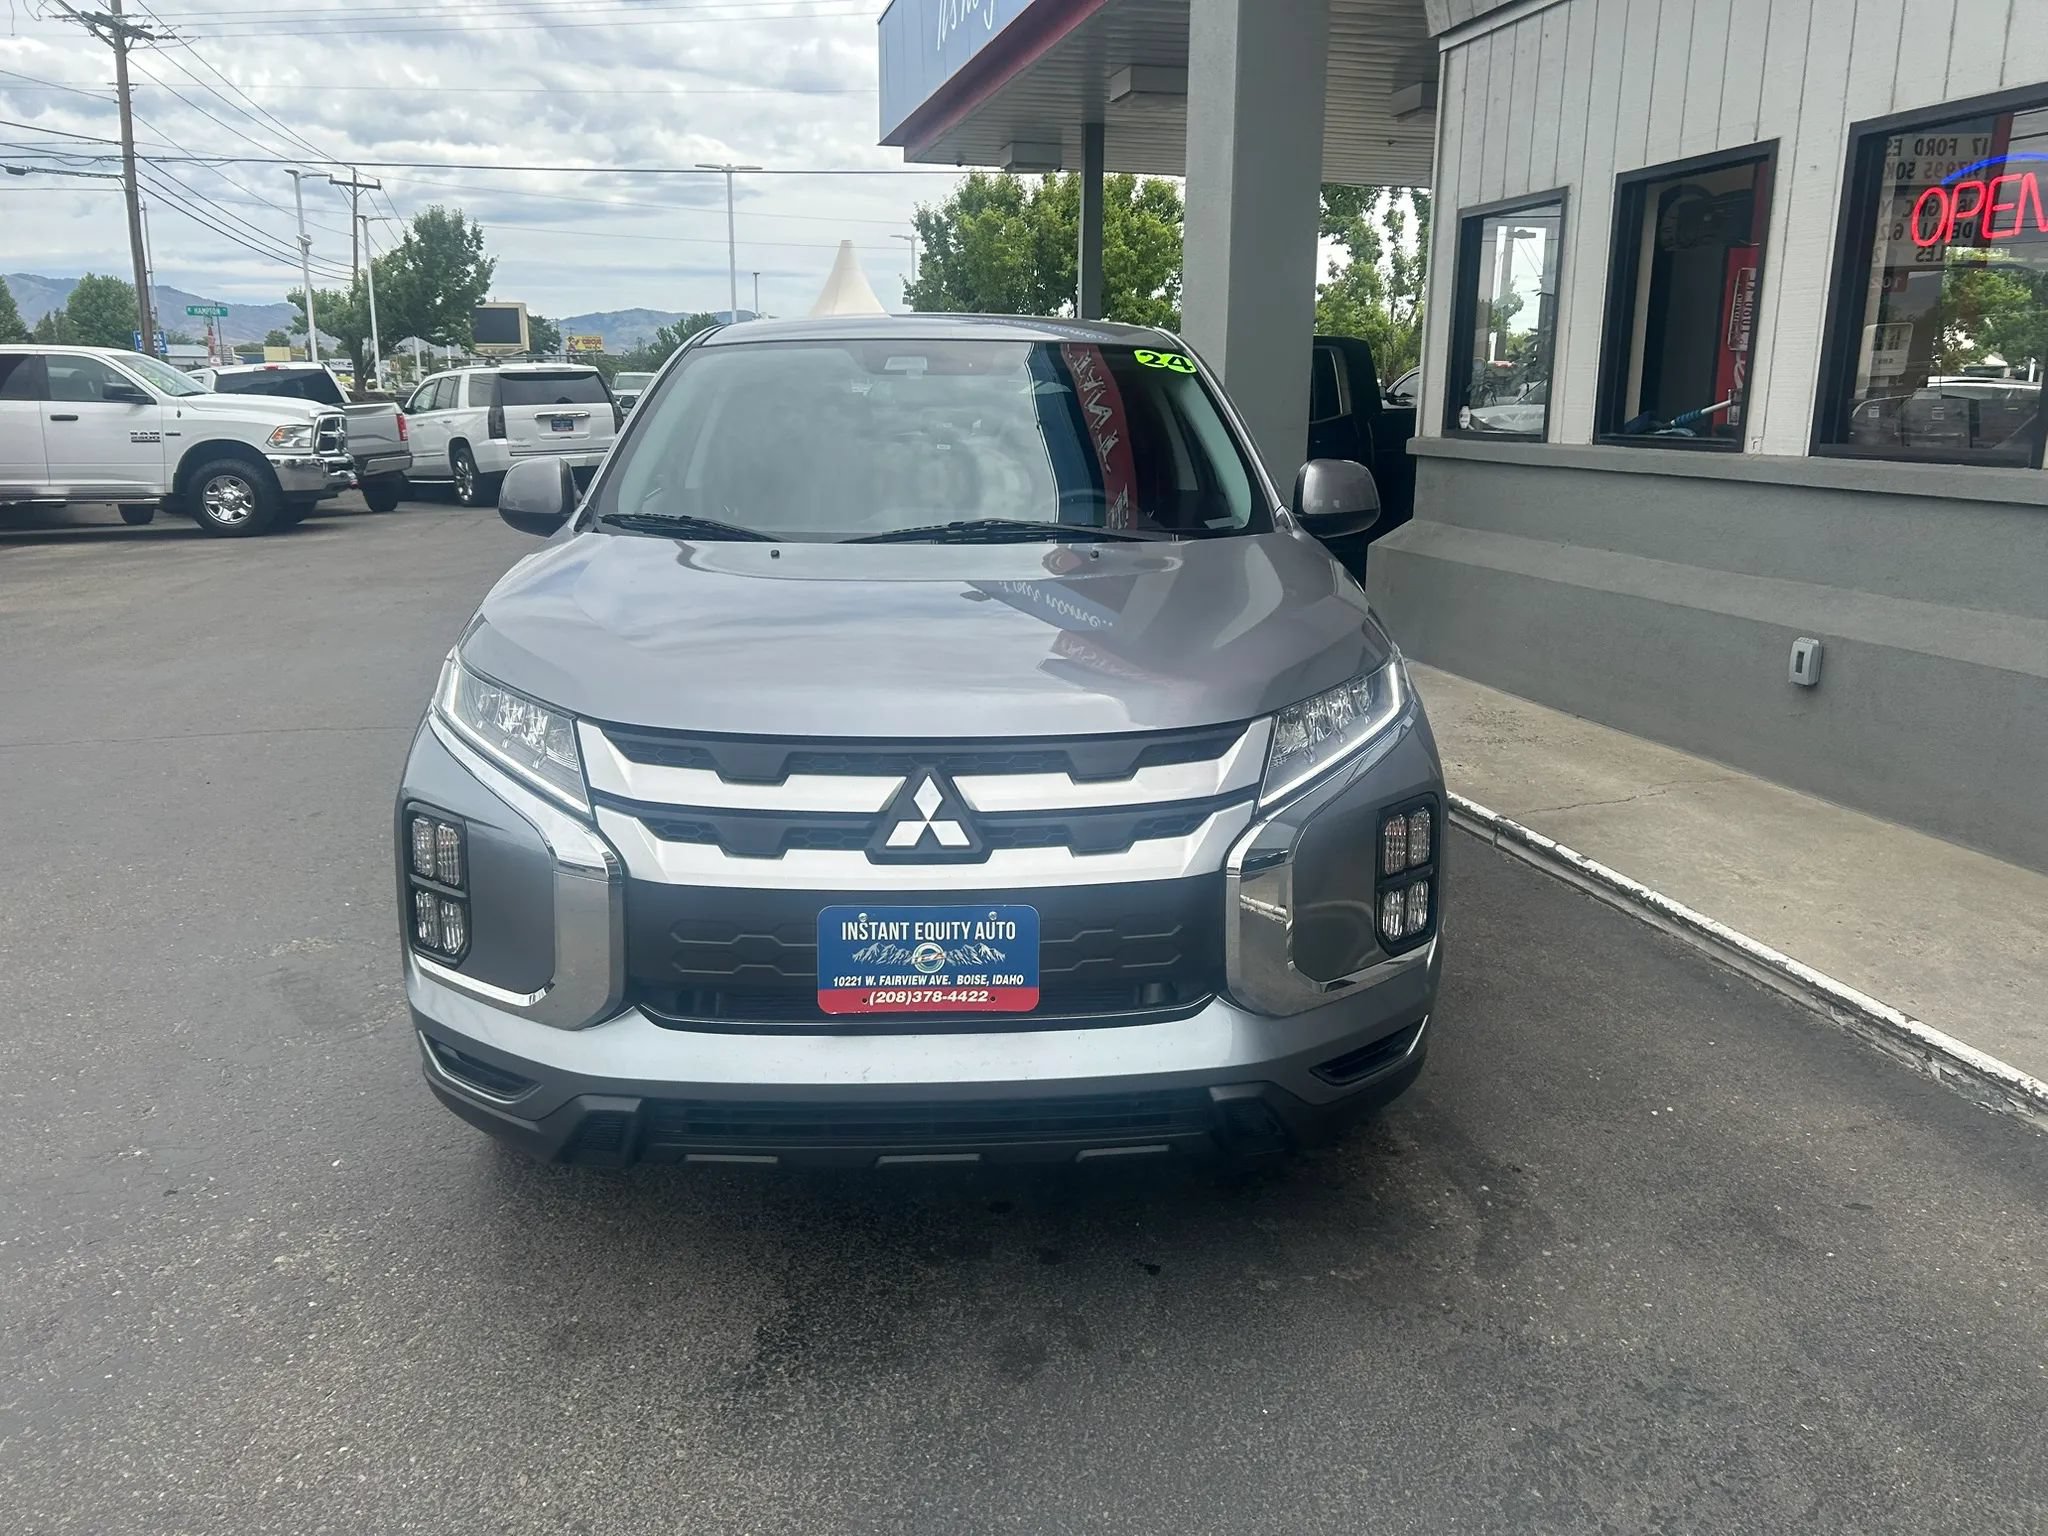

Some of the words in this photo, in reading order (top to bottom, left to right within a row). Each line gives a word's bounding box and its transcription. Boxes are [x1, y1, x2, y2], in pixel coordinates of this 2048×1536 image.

[1912, 172, 2048, 247] OPEN
[1138, 351, 1194, 372] 24
[842, 922, 909, 940] INSTANT
[915, 921, 971, 941] EQUITY
[974, 921, 1016, 940] AUTO
[833, 975, 861, 987] 10221
[865, 975, 877, 986] W.
[879, 975, 927, 986] FAIRVIEW
[929, 974, 951, 985] AVE.
[957, 974, 990, 987] BOISE,
[992, 974, 1024, 985] IDAHO
[869, 990, 989, 1006] (208)378-4422
